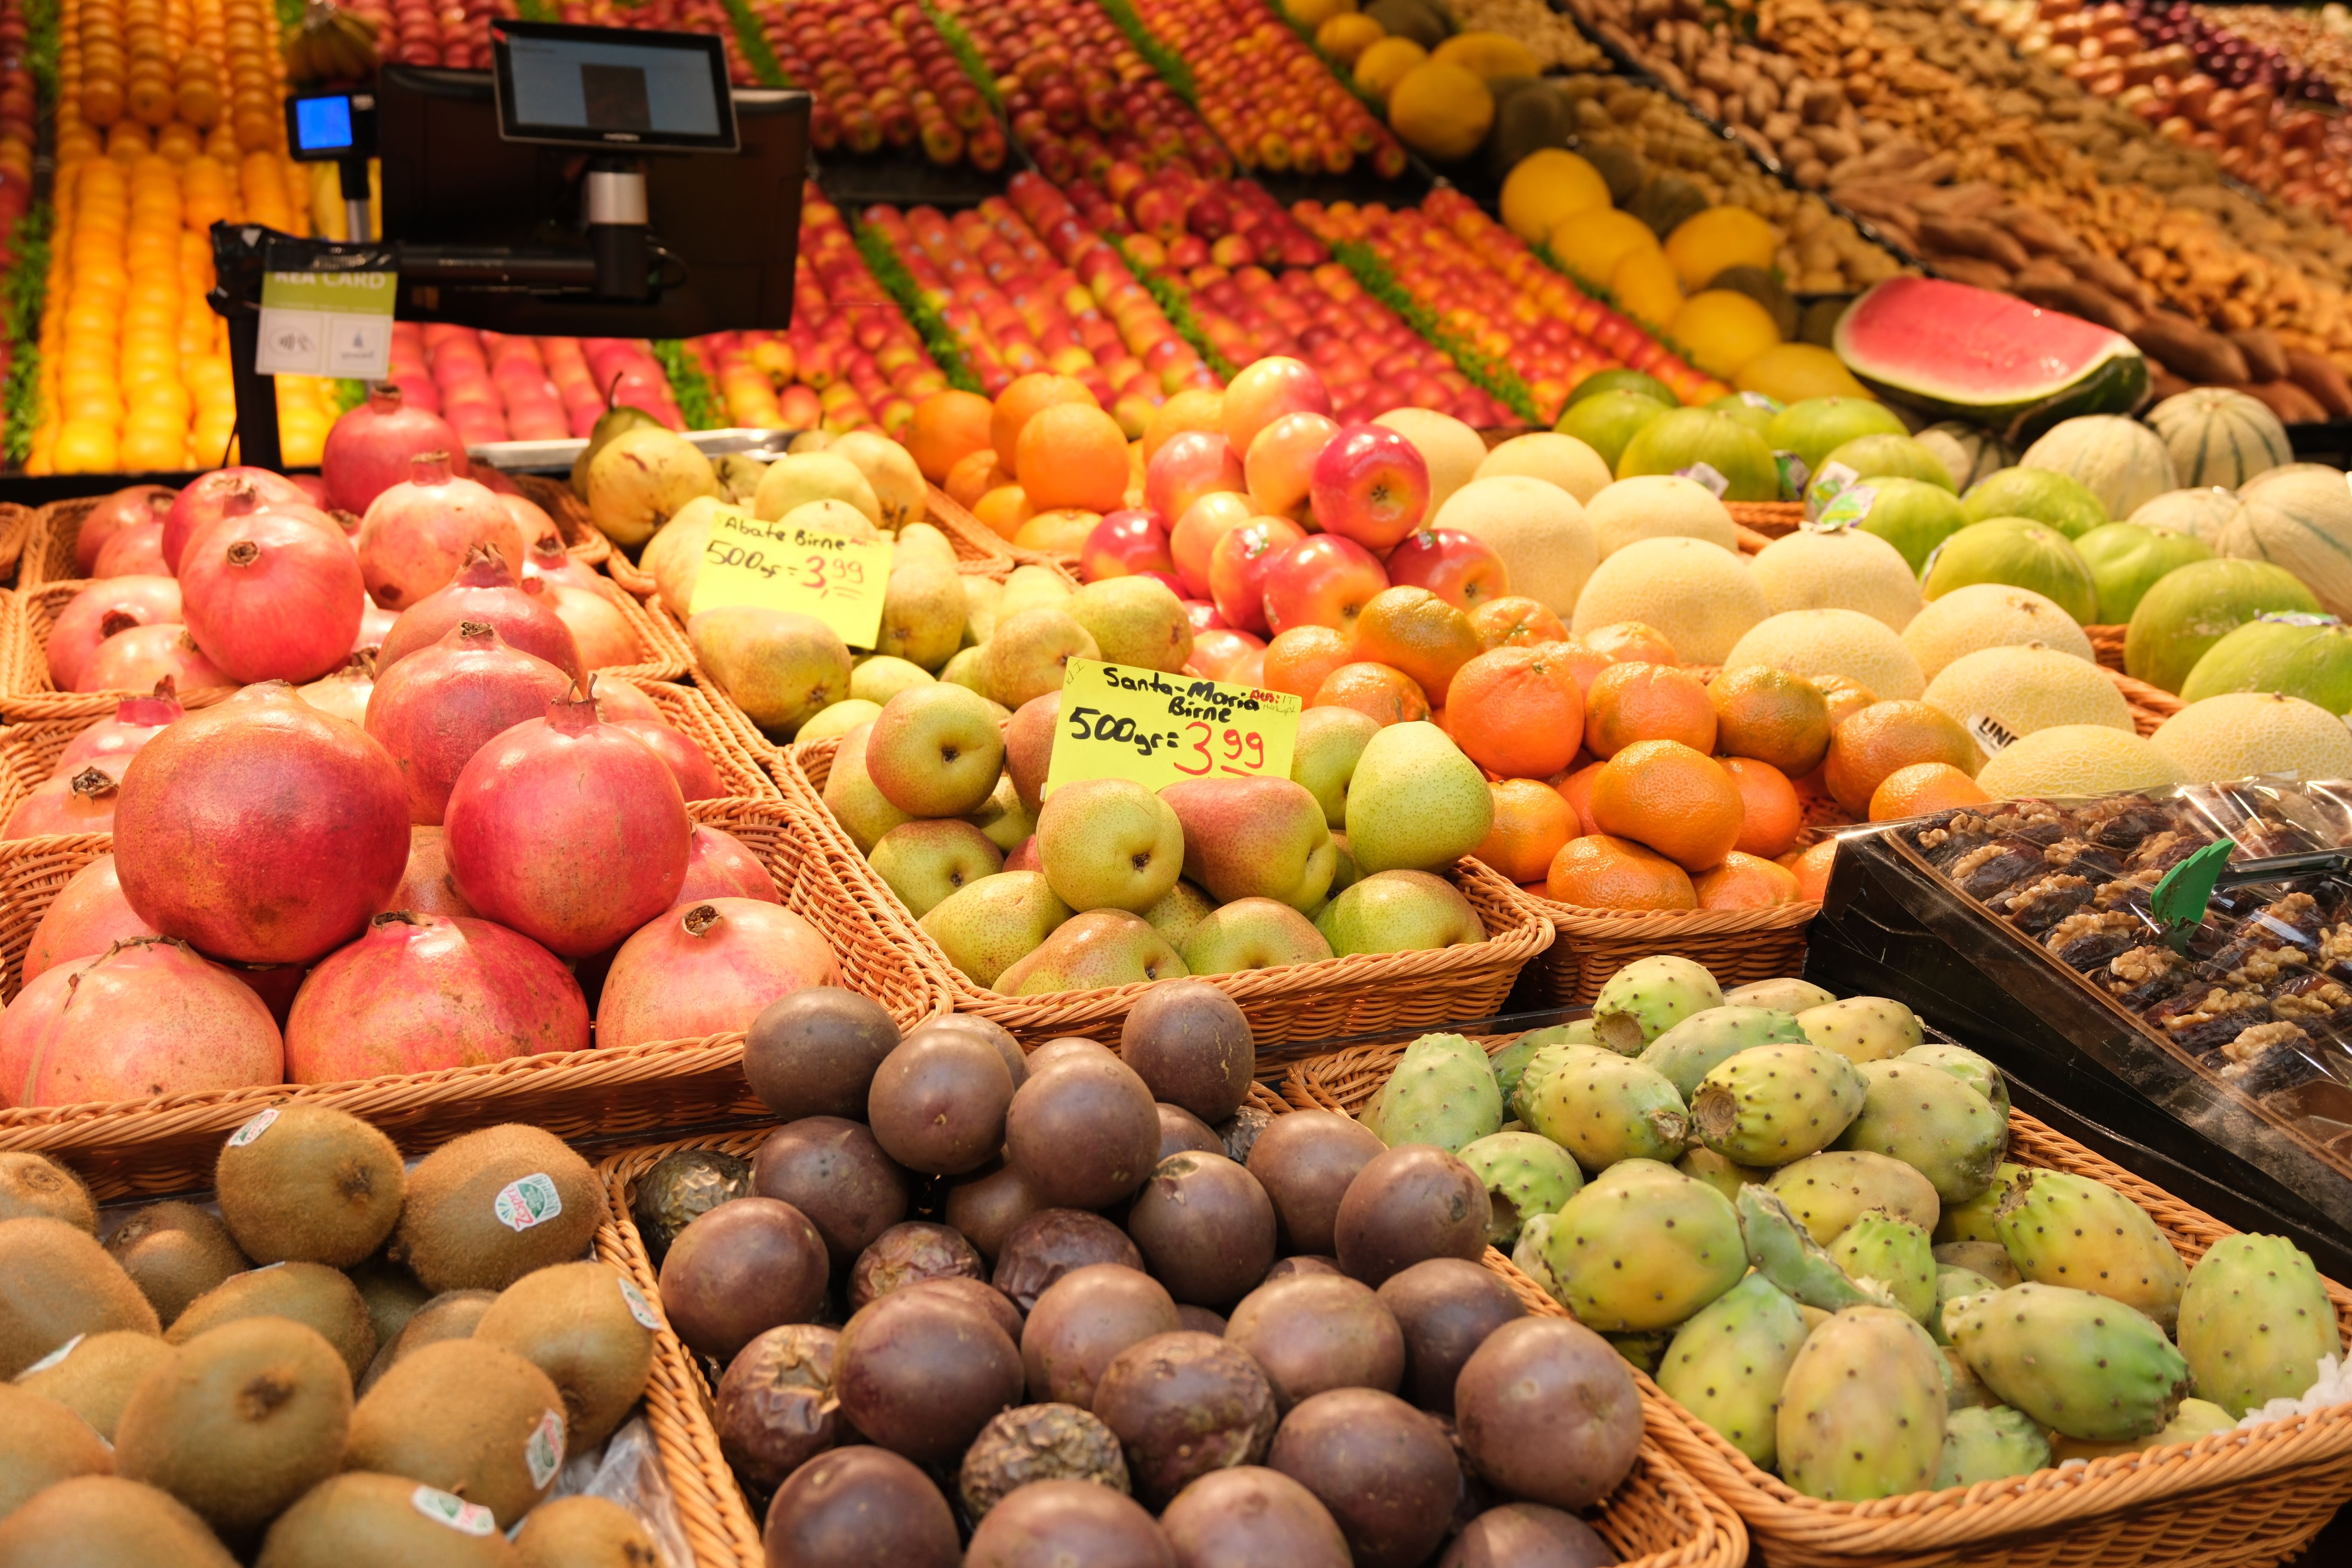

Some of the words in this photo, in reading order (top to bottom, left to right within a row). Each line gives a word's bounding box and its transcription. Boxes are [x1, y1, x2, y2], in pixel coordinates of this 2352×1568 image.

[323, 272, 386, 289] CARD
[725, 517, 785, 541] Abate
[795, 529, 845, 550] Birne
[1168, 696, 1231, 723] Birne
